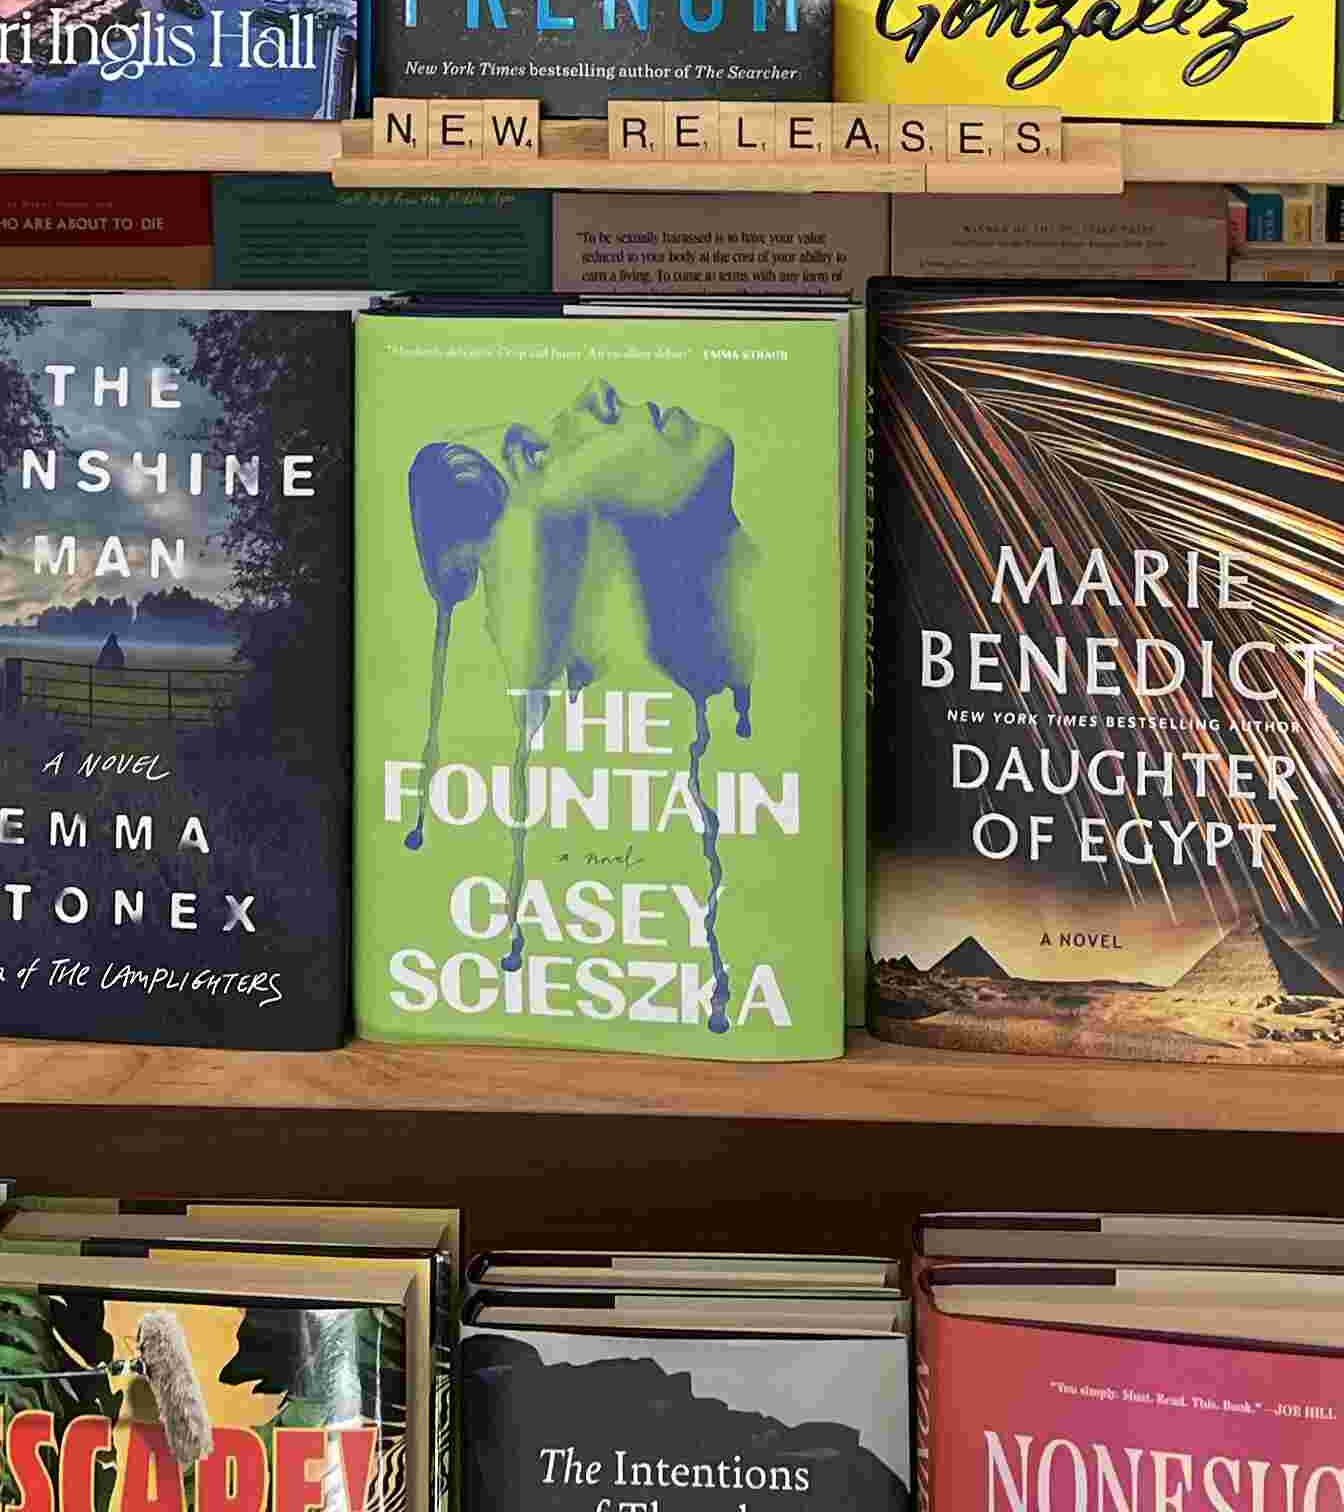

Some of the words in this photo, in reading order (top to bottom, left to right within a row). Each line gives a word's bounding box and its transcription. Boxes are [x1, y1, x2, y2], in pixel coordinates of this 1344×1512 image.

[406, 60, 437, 76] New
[440, 60, 474, 76] York
[478, 61, 526, 77] Times
[529, 61, 616, 81] bestselling
[619, 63, 672, 80] author
[674, 62, 693, 80] of
[696, 65, 726, 80] The
[727, 65, 801, 81] Searcher
[23, 216, 54, 232] ARE
[57, 216, 108, 232] ABOUT
[113, 216, 133, 232] TO
[140, 216, 166, 232] DIE
[46, 364, 182, 410] THE
[990, 546, 1258, 611] MARIE
[920, 628, 1340, 703] BENEDICT
[540, 1445, 603, 1486] The
[614, 1448, 810, 1492] Intentions
